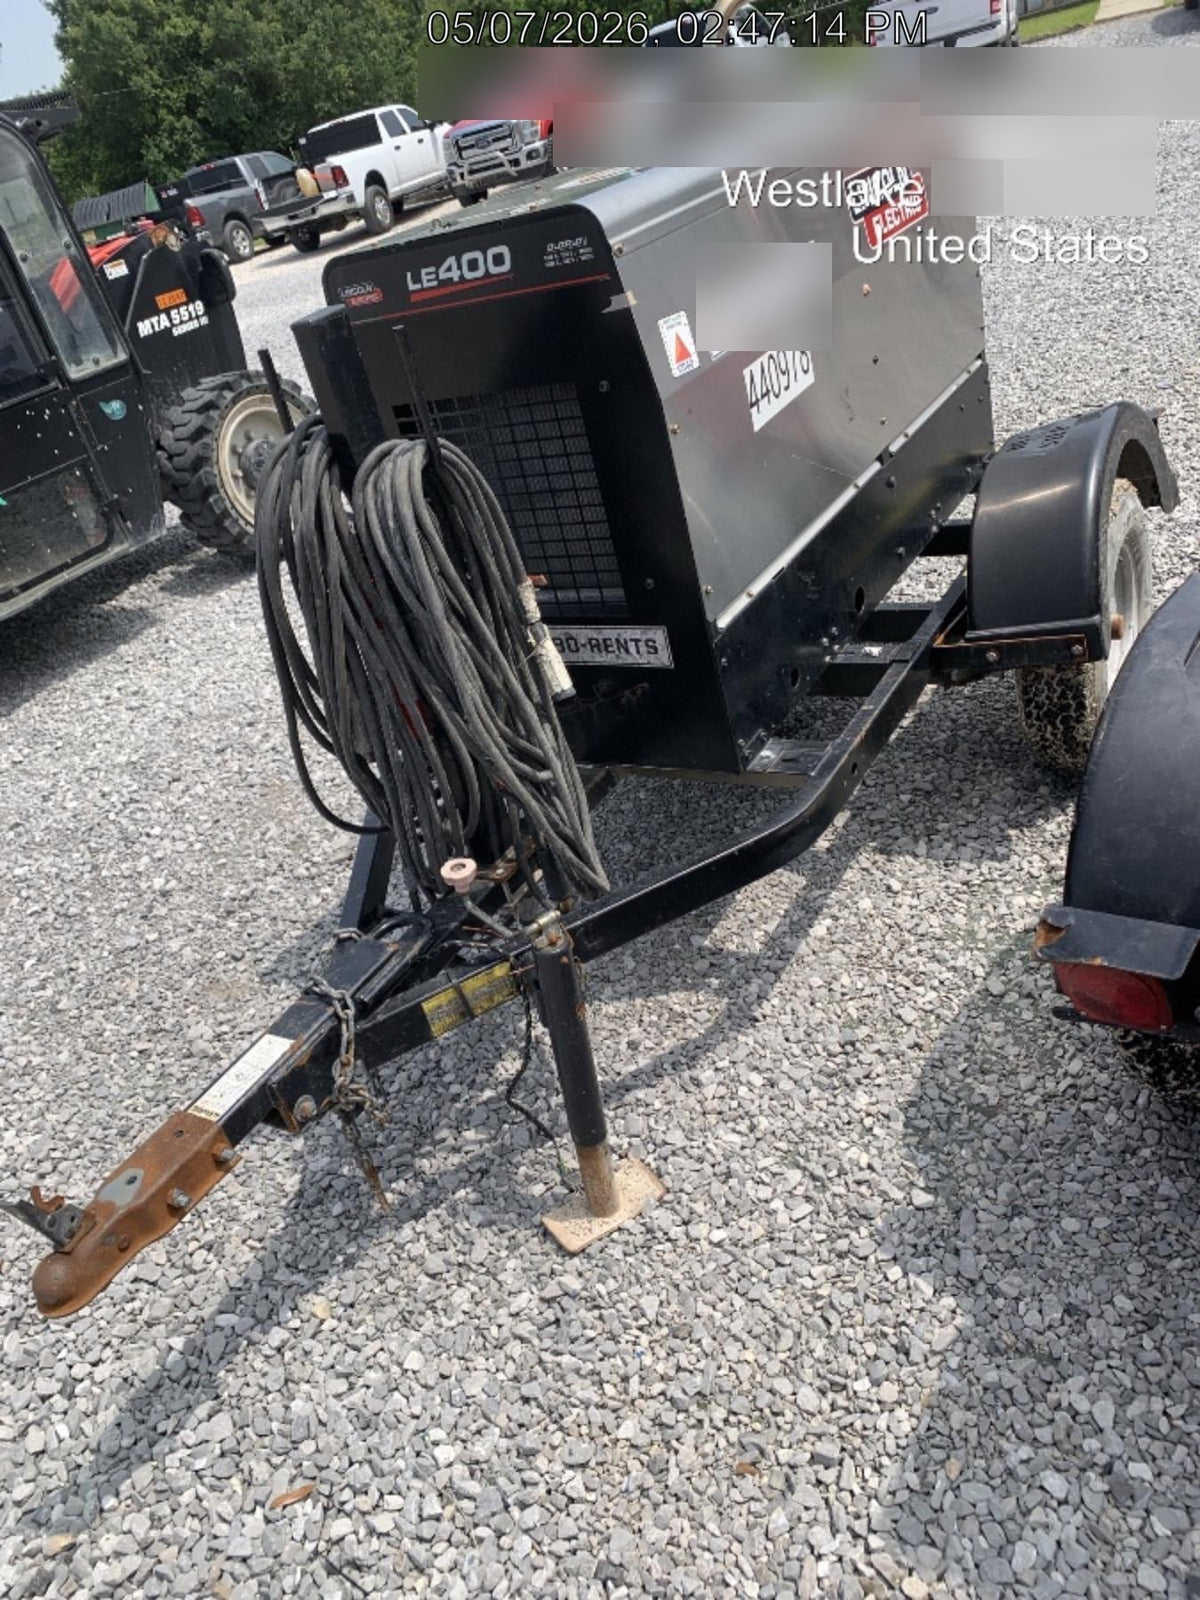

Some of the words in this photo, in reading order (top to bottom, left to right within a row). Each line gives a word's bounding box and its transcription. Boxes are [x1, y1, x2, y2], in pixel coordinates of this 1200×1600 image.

[406, 244, 511, 291] LE400
[137, 313, 171, 338] MTA
[170, 300, 205, 325] 5519
